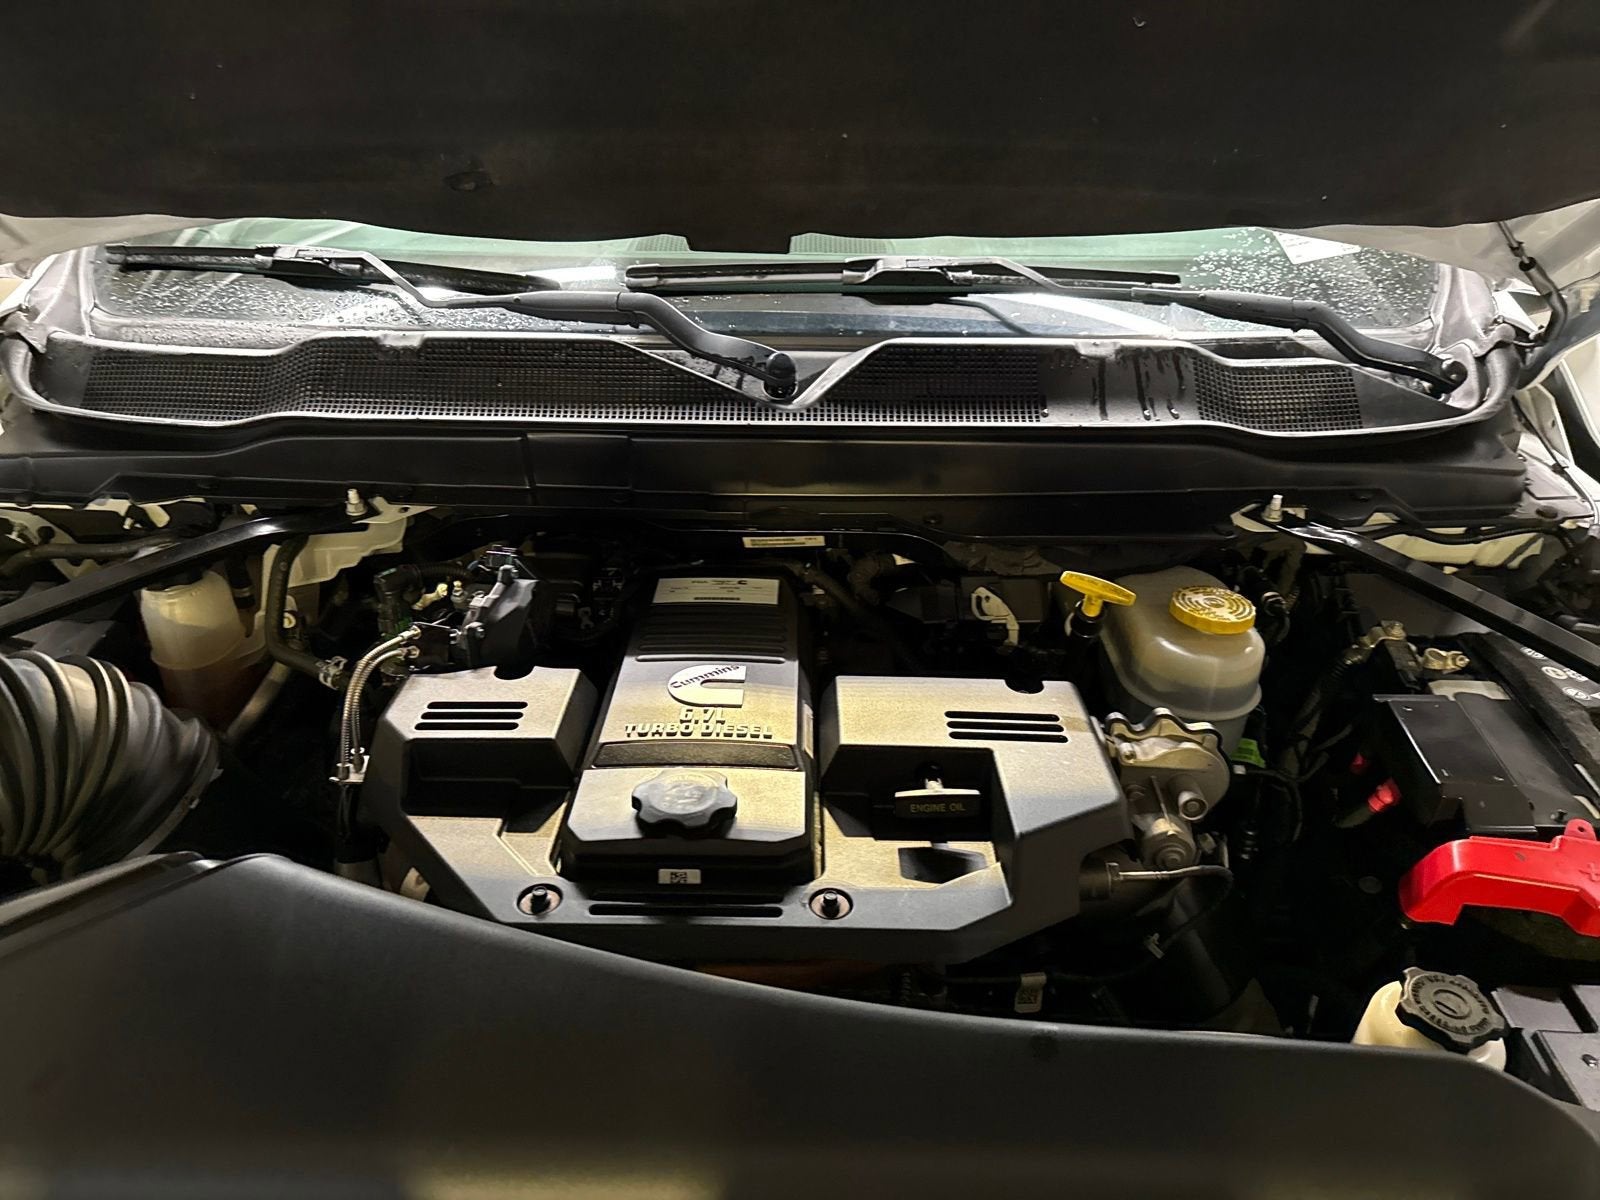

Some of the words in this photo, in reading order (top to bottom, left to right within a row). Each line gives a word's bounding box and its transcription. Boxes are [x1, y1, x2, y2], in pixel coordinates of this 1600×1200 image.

[669, 664, 740, 688] Cummins
[680, 707, 726, 725] 6.7L
[625, 722, 694, 738] TURBO
[701, 723, 773, 740] DIESEL
[909, 803, 946, 813] ENGINE
[949, 802, 967, 812] OIL
